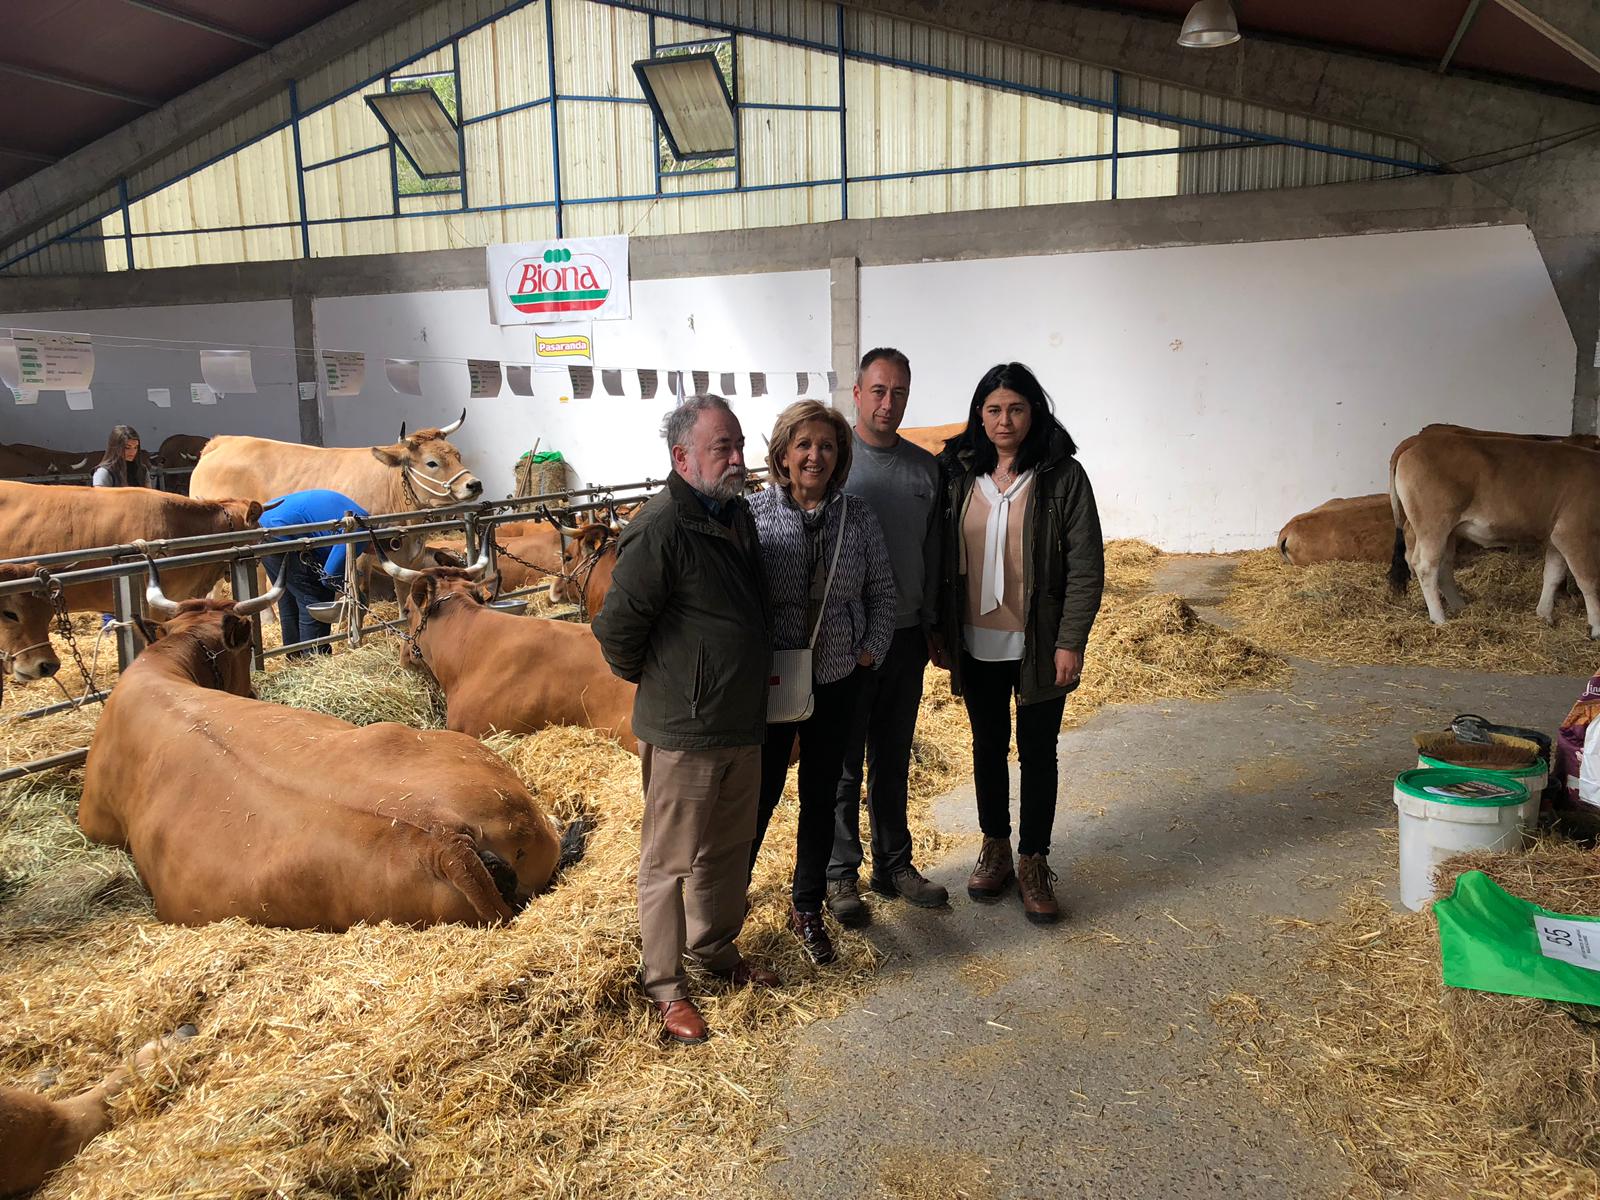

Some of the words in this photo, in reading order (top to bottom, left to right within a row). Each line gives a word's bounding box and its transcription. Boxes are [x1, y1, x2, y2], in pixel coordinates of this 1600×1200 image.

[517, 263, 600, 294] Biona
[539, 340, 587, 352] Pasaranda
[1544, 927, 1572, 946] 55
